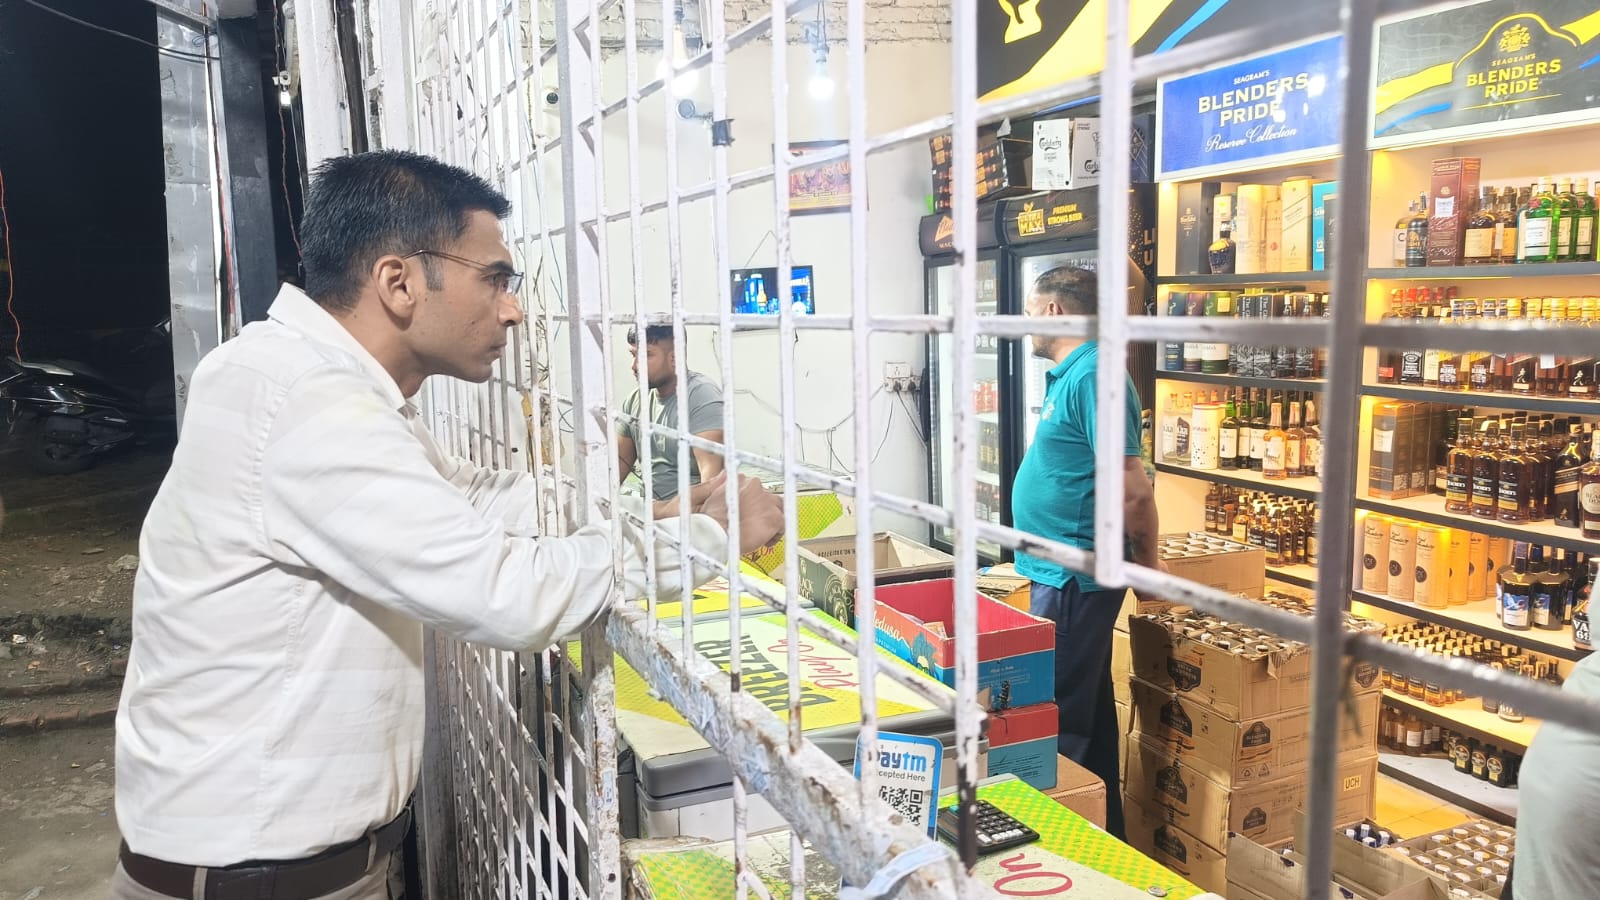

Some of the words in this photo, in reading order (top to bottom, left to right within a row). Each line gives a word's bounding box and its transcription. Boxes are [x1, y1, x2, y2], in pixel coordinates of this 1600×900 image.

[1491, 53, 1537, 67] SEAGRAM'S
[1233, 69, 1271, 85] SEAGRAM'S
[1466, 59, 1562, 87] BLENDERS
[1198, 73, 1309, 113] BLENDERS
[1485, 78, 1539, 98] PRIDE
[1220, 101, 1282, 128] PRIDE
[1204, 133, 1247, 153] Reserve
[1245, 124, 1298, 144] Collection
[873, 612, 906, 642] edusa
[877, 751, 927, 772] aytm
[878, 769, 905, 780] cepted
[907, 772, 926, 783] Here
[1345, 777, 1360, 790] UCH
